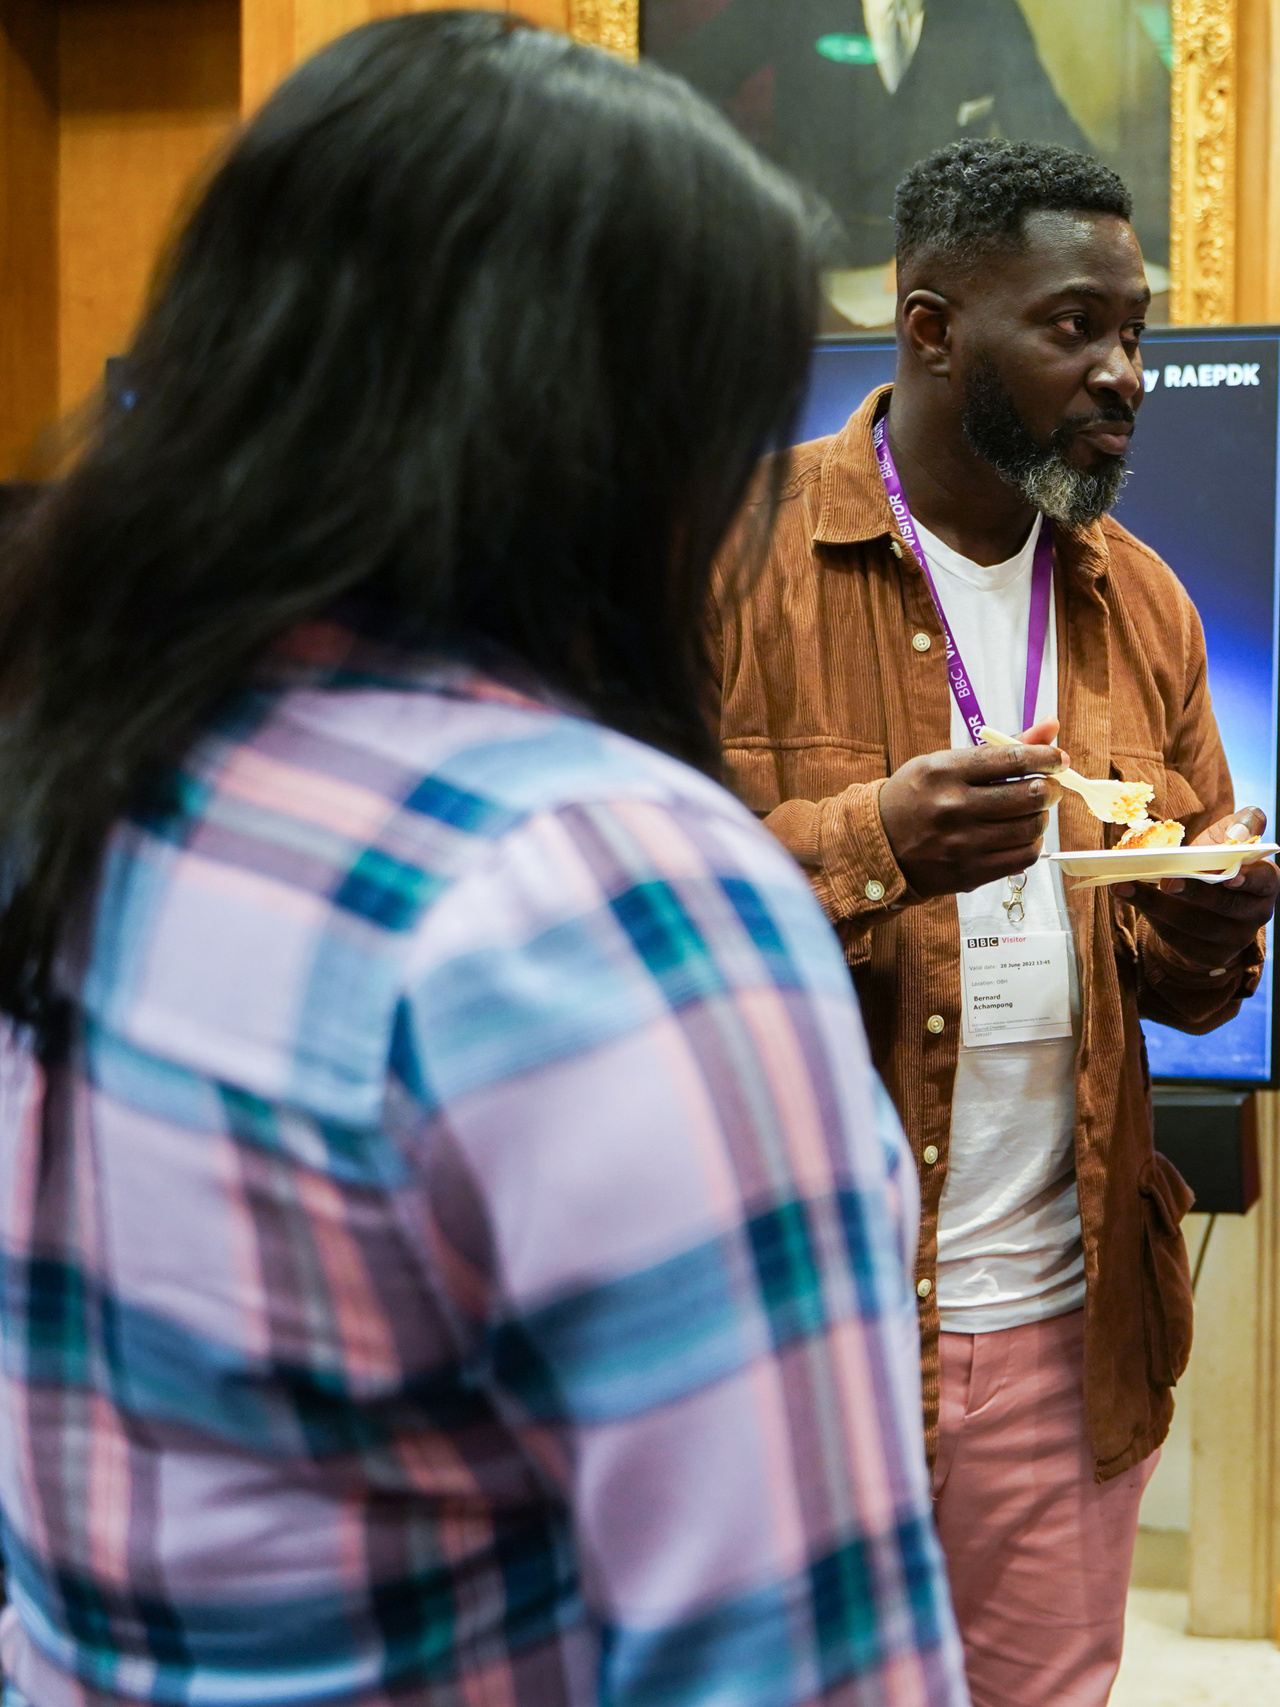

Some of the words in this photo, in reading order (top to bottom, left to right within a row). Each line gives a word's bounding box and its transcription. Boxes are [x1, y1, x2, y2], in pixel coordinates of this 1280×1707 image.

[1142, 369, 1160, 392] y
[1164, 363, 1260, 387] RAEPDK
[878, 452, 894, 479] BBC
[889, 493, 916, 547] VISITOR
[950, 668, 971, 699] BBC
[967, 937, 999, 948] BBC
[1001, 936, 1027, 944] Visitor
[973, 994, 1001, 1002] Bernard
[973, 1002, 1013, 1010] Achampong
